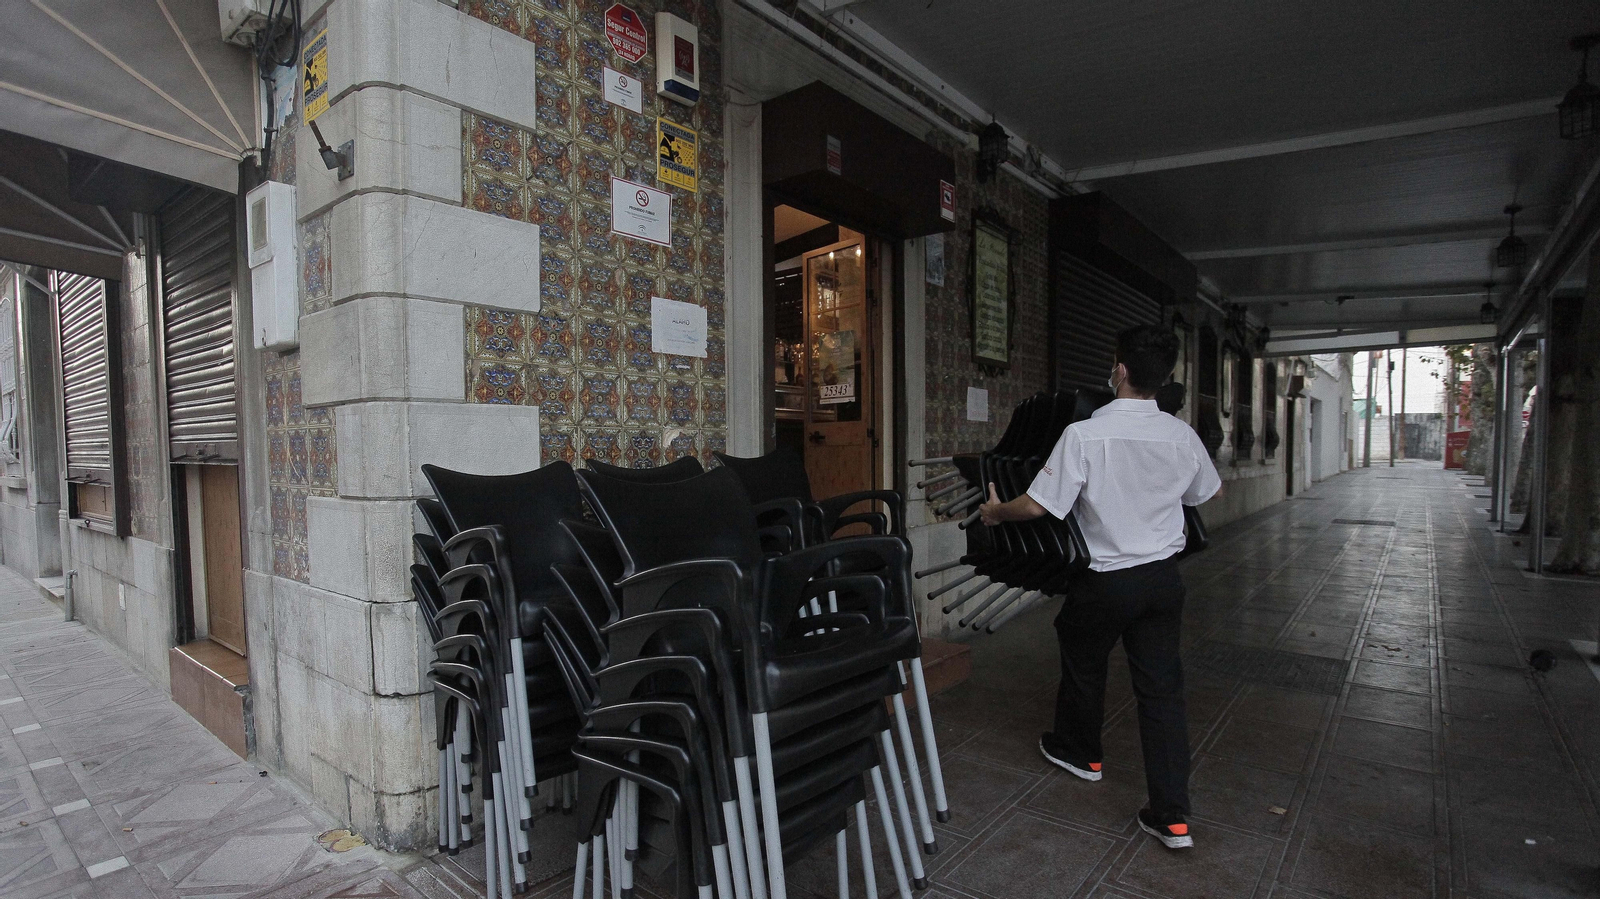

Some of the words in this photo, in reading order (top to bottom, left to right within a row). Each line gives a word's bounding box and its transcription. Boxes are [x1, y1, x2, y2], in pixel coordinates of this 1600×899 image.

[607, 18, 625, 33] Segur
[625, 26, 646, 43] Control
[304, 34, 327, 60] CONECTADA
[660, 121, 695, 139] CONECTADA
[660, 160, 695, 177] PROSEGUR
[824, 384, 848, 397] 25343
